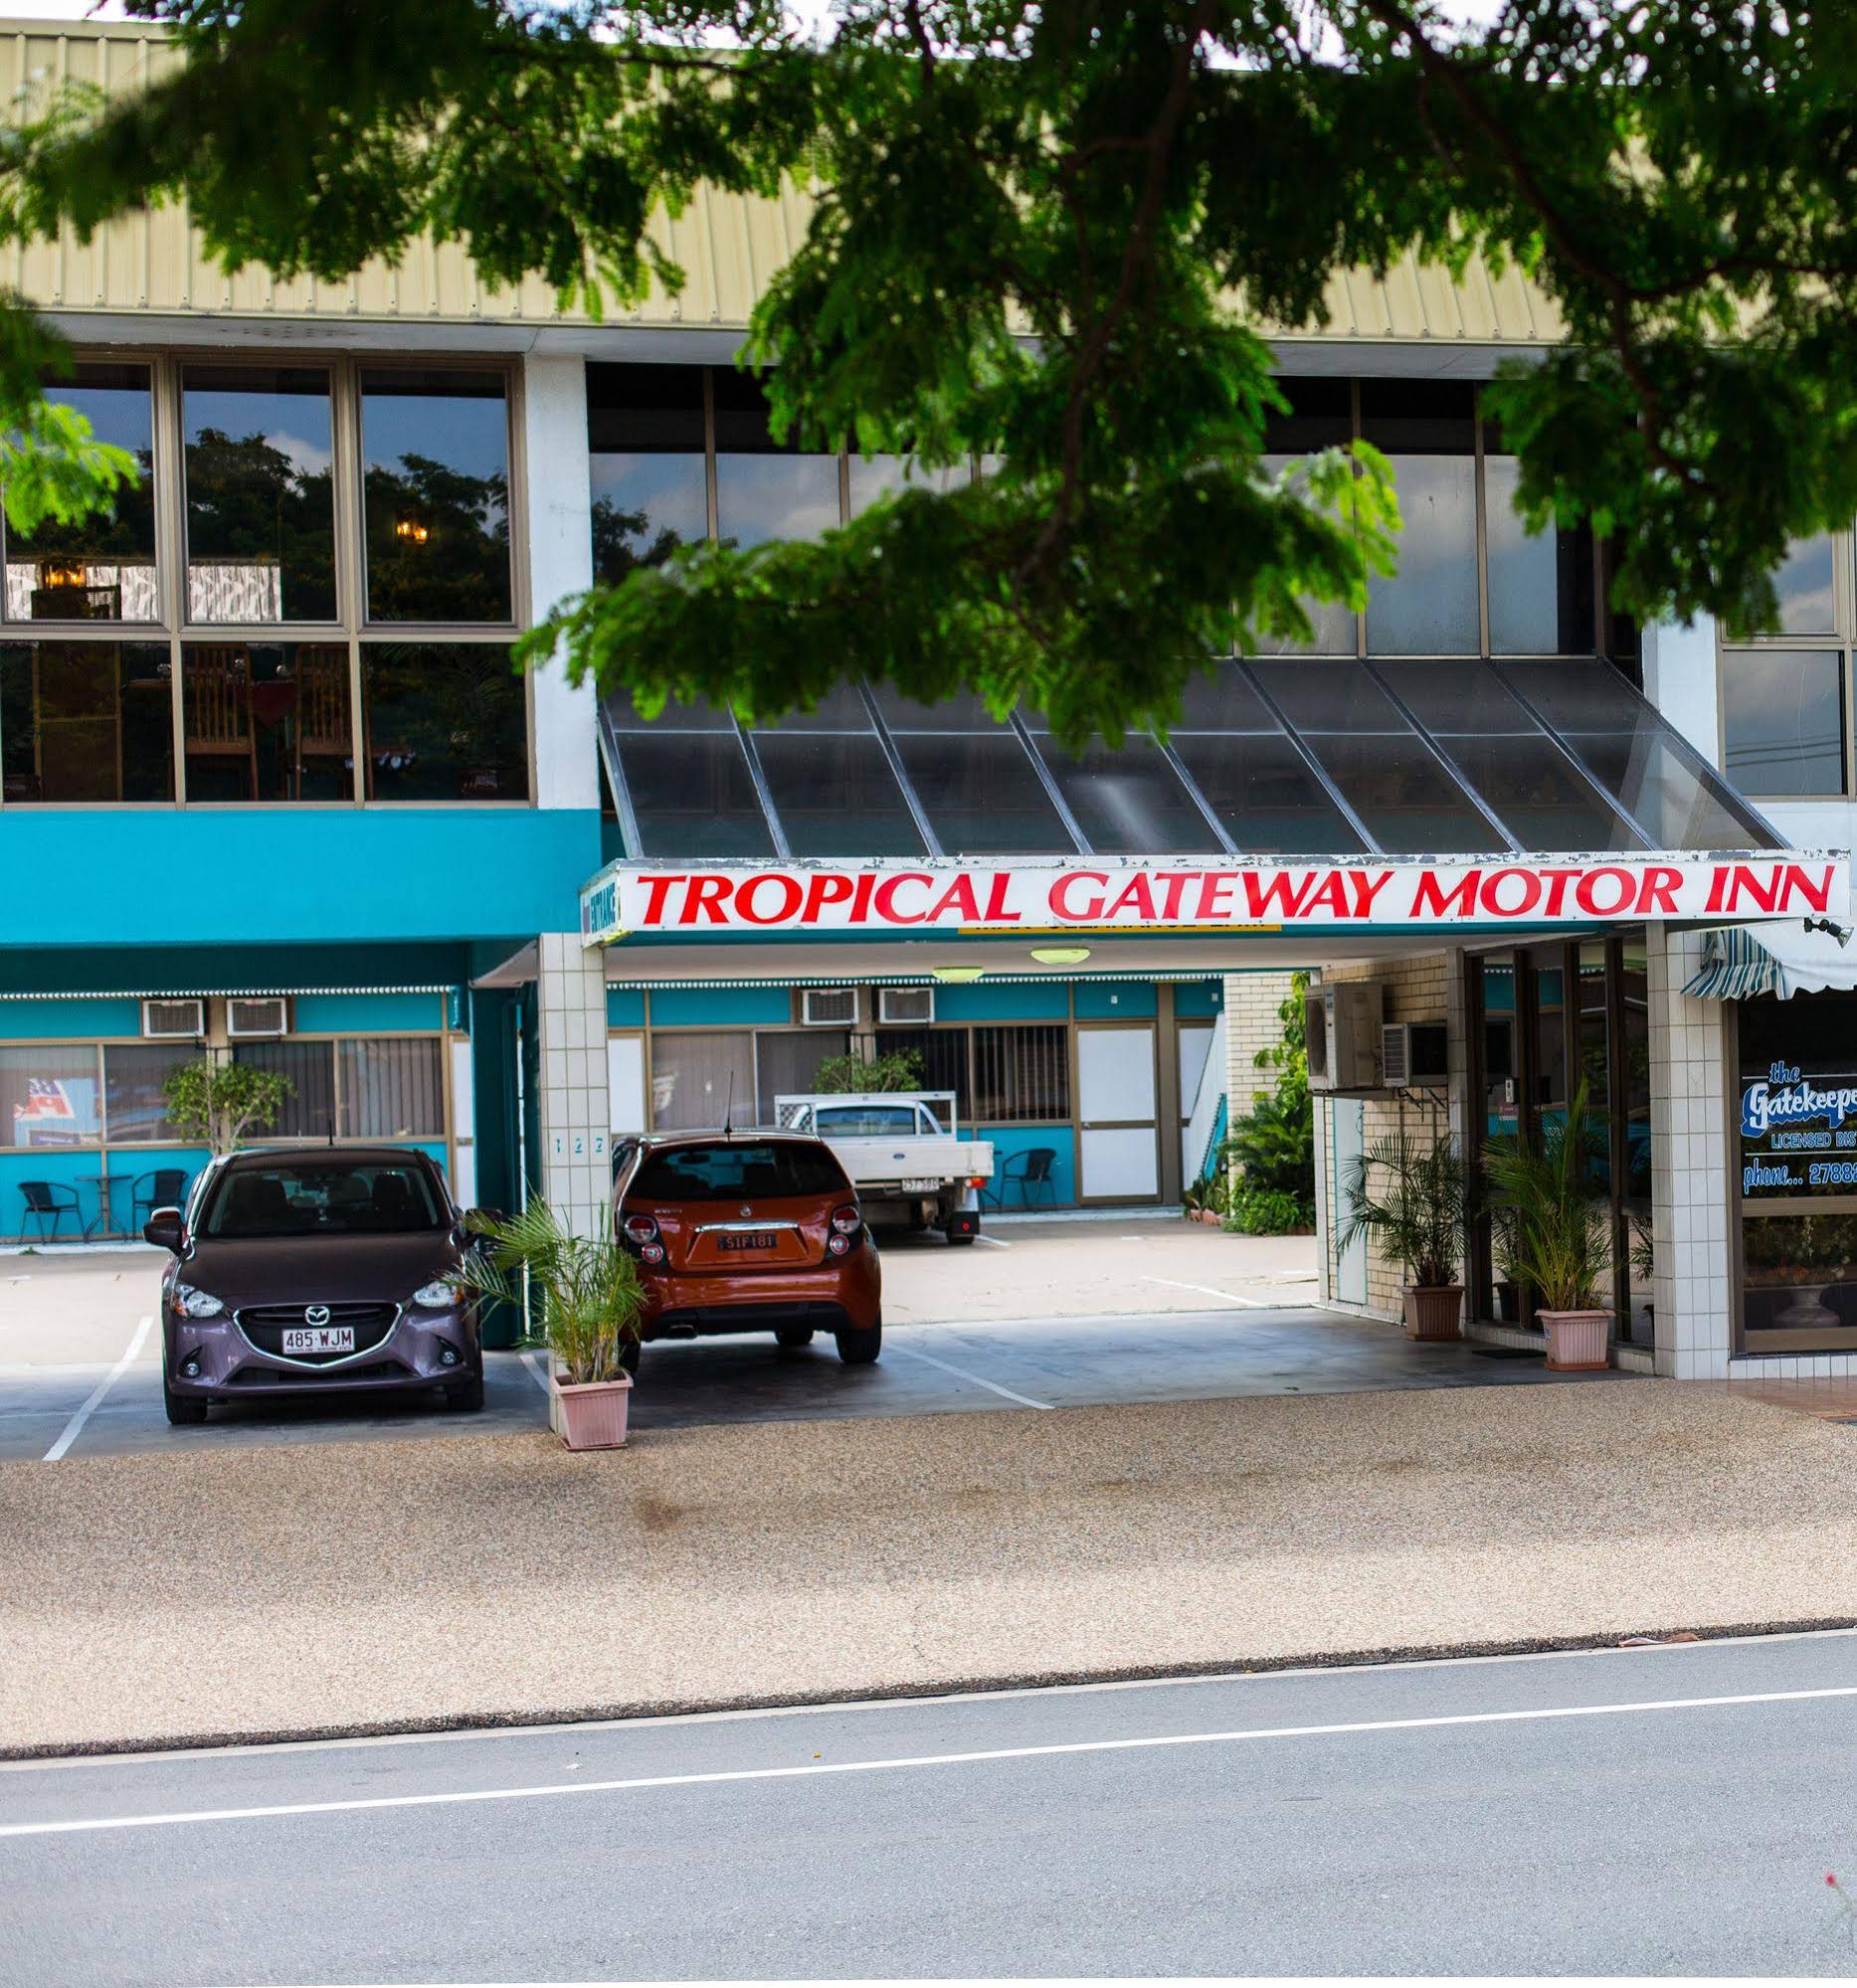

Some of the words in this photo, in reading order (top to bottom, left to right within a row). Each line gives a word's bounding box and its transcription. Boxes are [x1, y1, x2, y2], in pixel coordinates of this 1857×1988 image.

[638, 873, 1020, 924] TROPICAL
[1049, 871, 1394, 920] GATEWAY
[1409, 868, 1683, 917] MOTOR
[1705, 865, 1834, 912] INN
[1768, 1060, 1800, 1083] the
[1770, 1132, 1831, 1149] LICENSED
